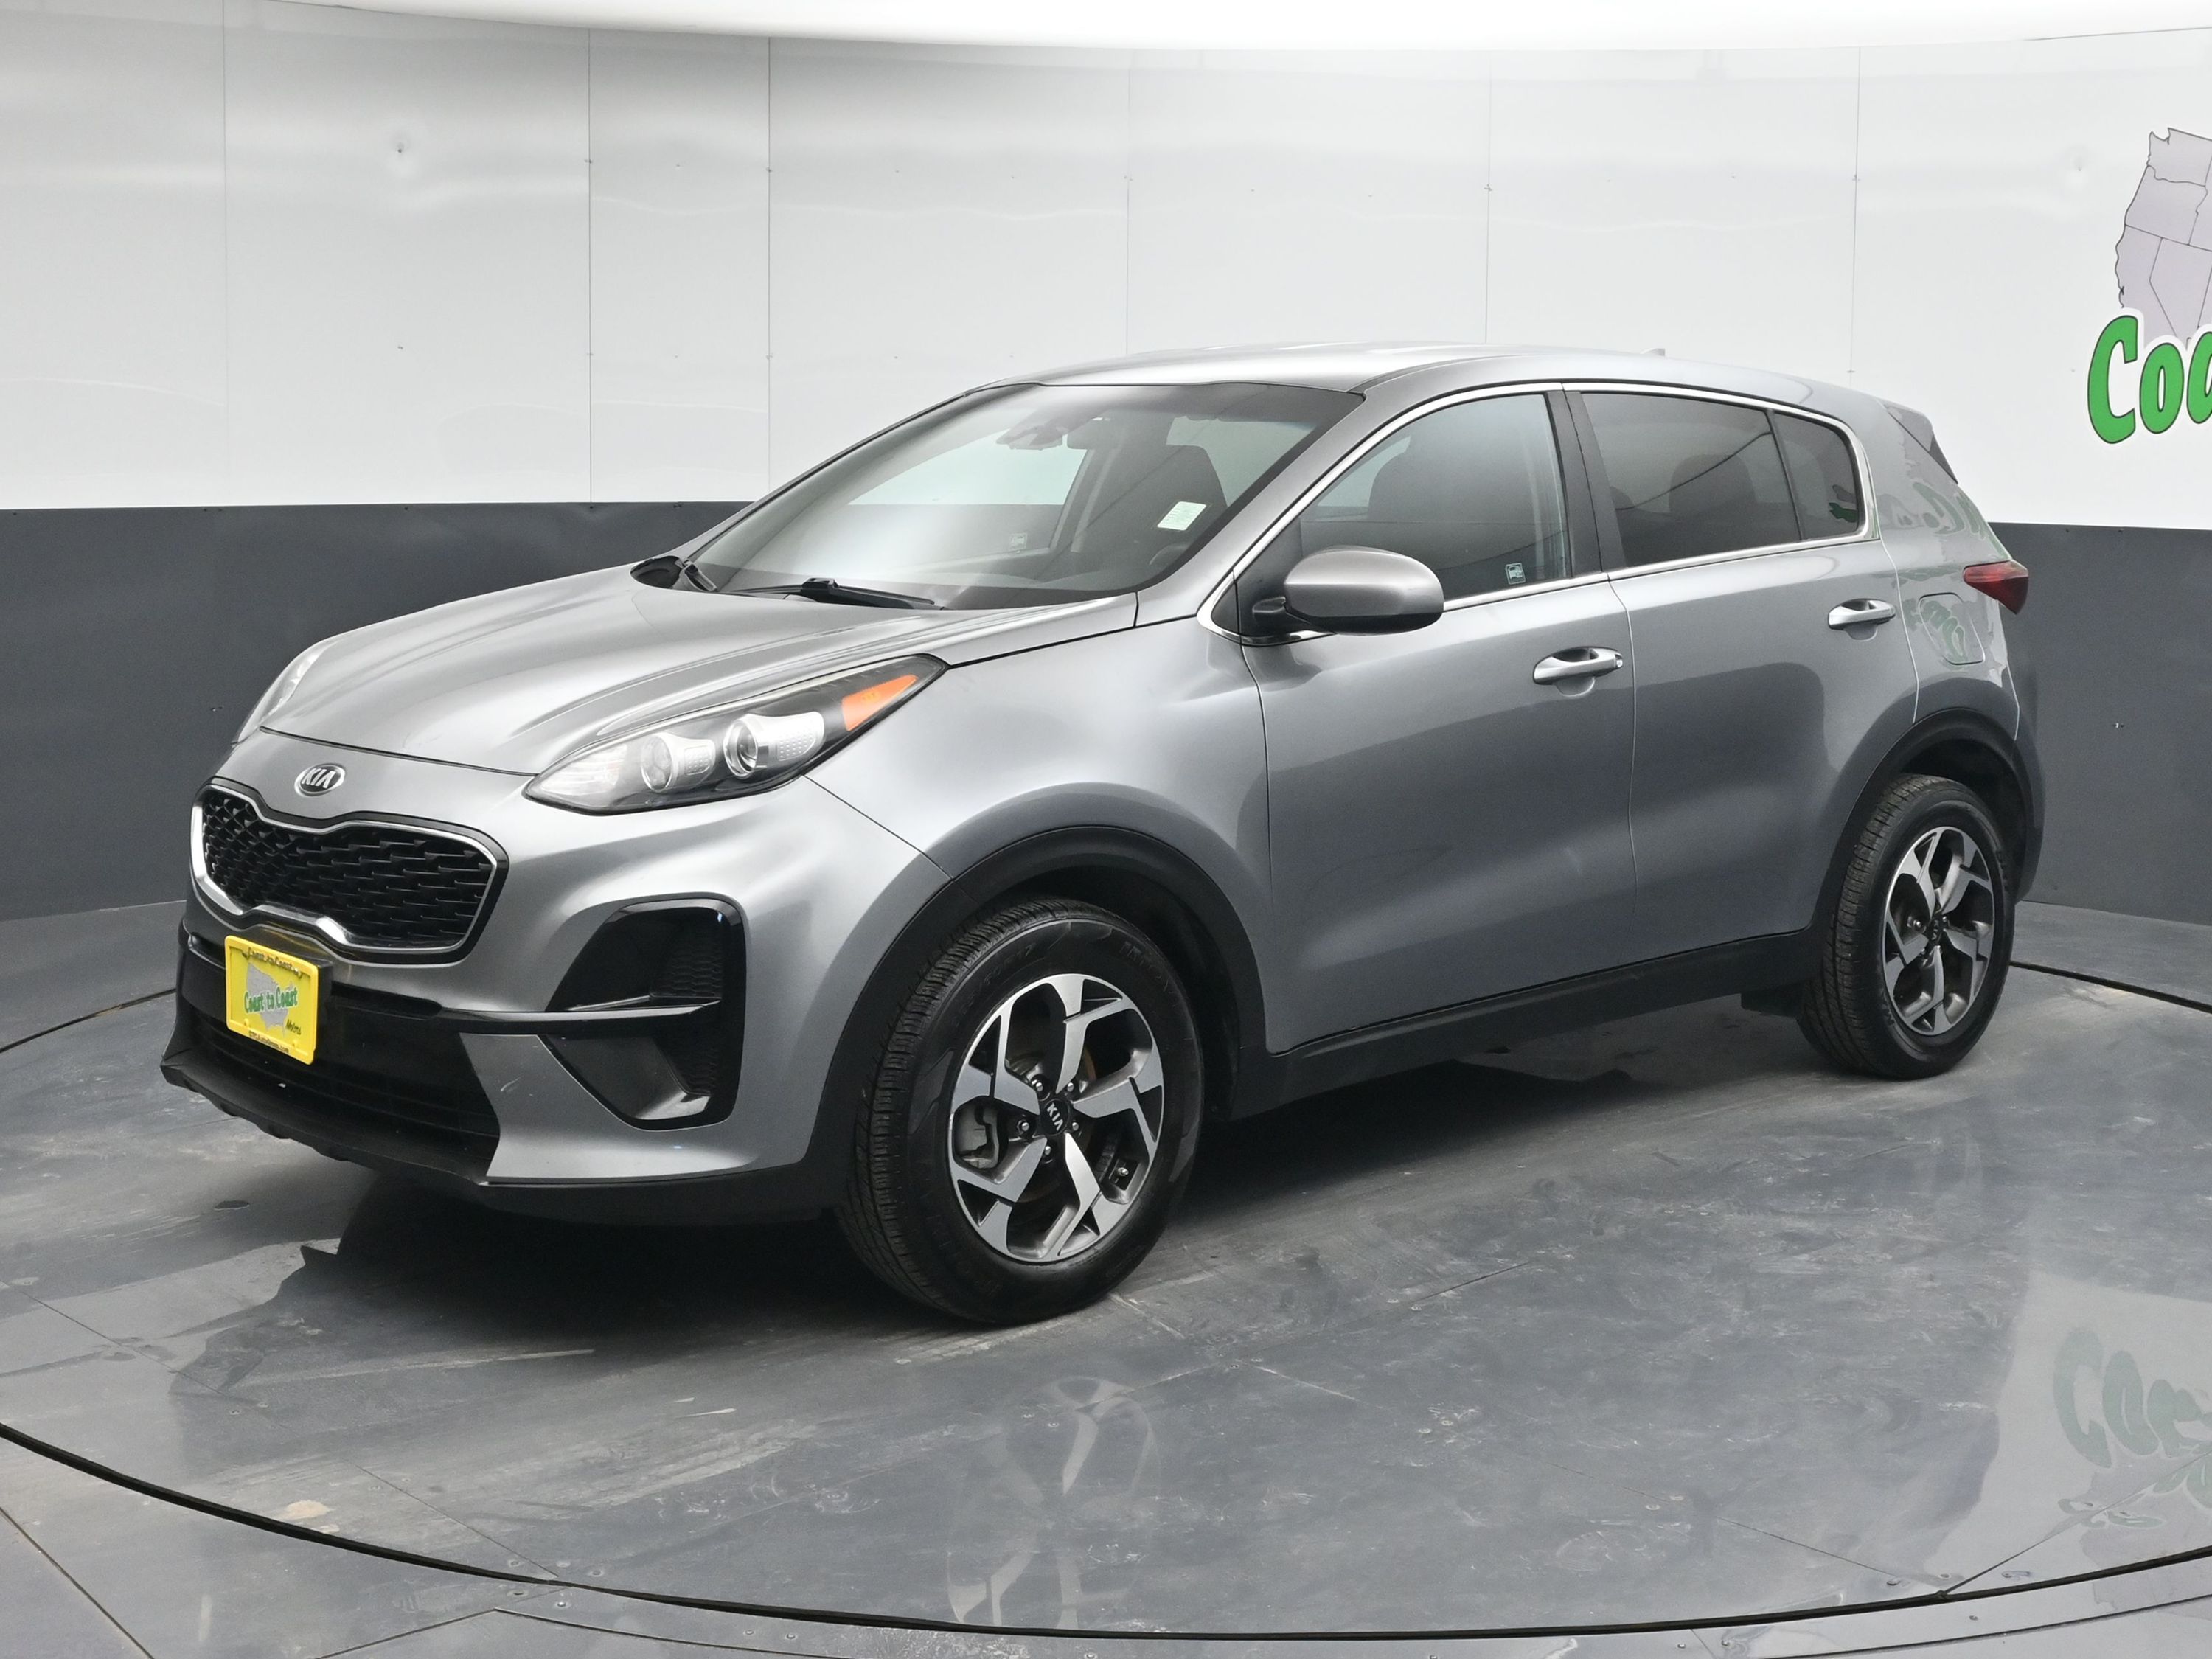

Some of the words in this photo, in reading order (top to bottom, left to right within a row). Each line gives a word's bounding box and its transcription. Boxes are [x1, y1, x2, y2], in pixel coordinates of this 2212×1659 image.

[301, 768, 336, 788] KIA
[244, 992, 264, 1013] Coast
[267, 992, 275, 1010] to
[276, 987, 298, 1008] Coast
[1047, 1102, 1063, 1131] KIA
